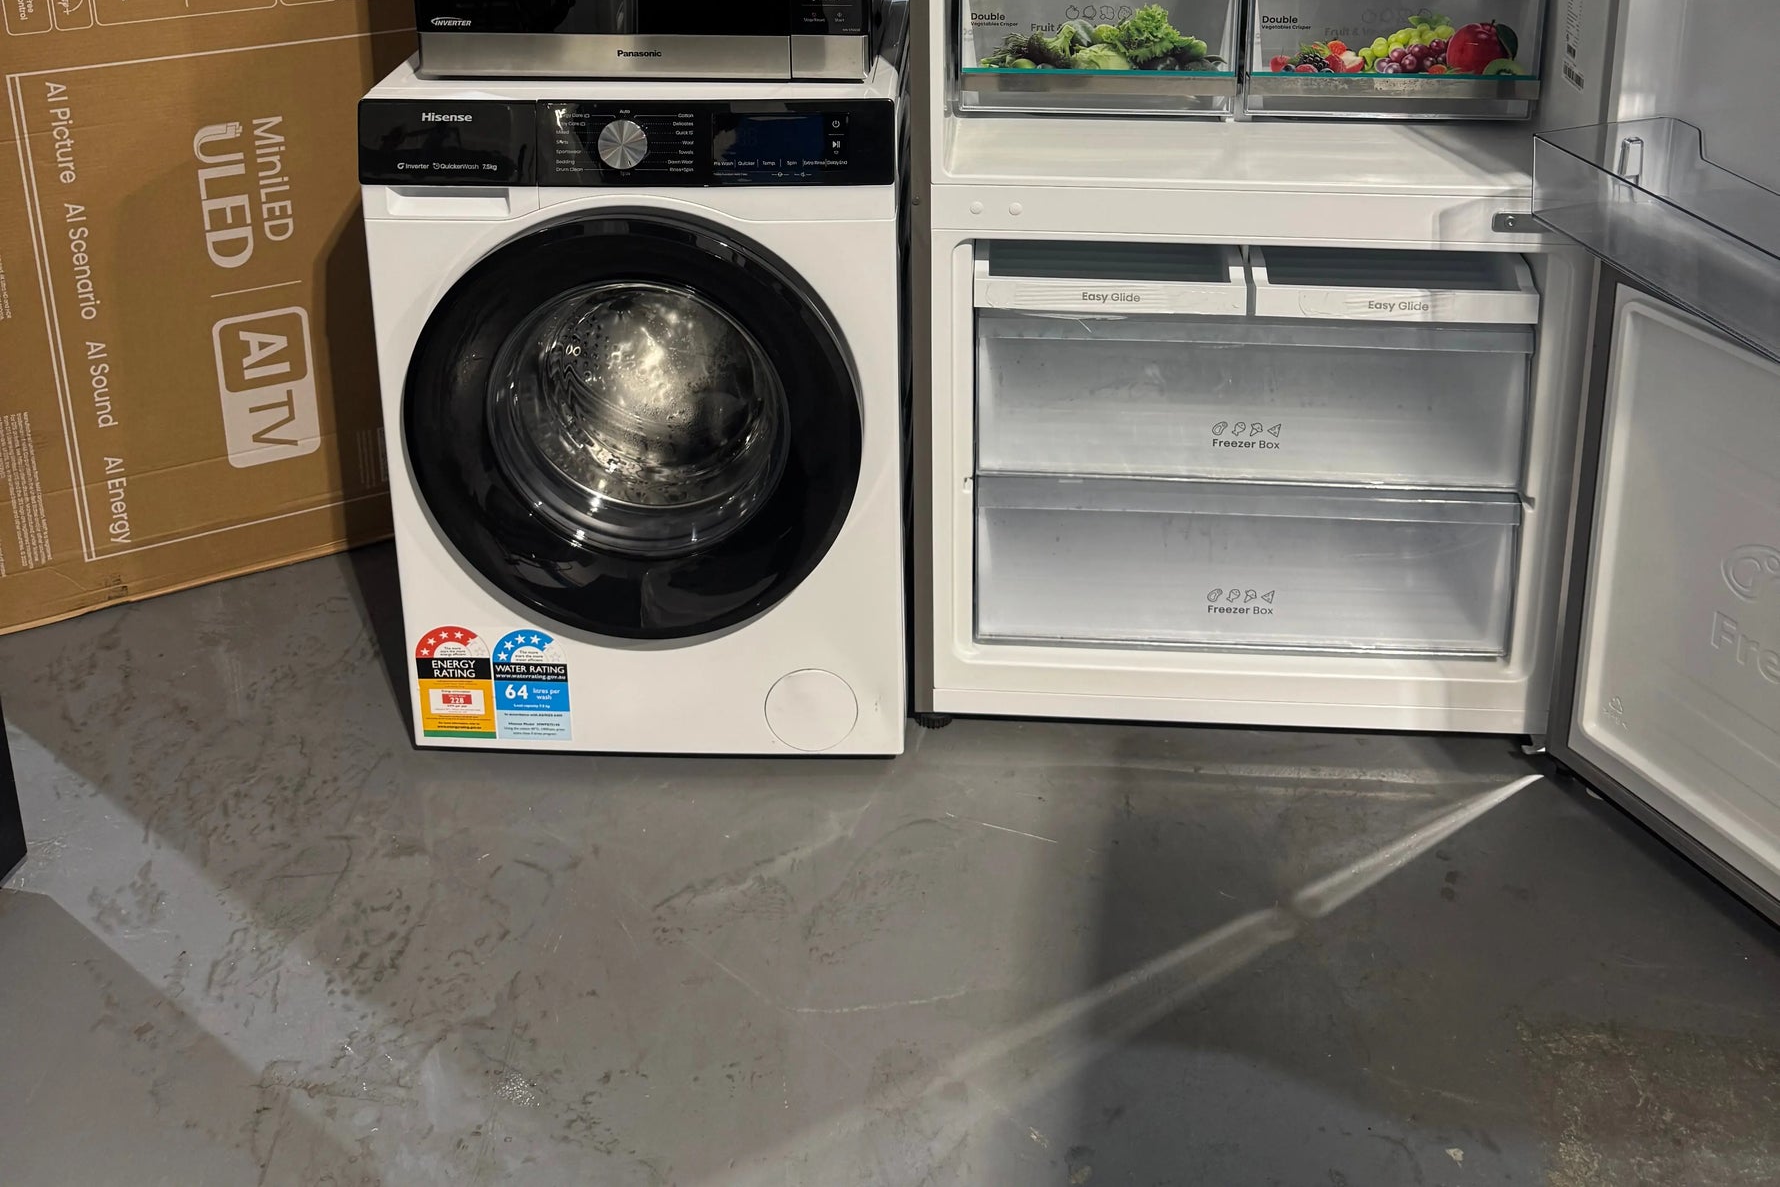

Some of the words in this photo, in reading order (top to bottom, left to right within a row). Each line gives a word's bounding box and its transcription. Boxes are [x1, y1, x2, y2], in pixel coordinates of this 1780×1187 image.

[435, 18, 472, 27] INVERTER
[1031, 23, 1054, 31] Fruit
[617, 50, 662, 58] Panasonic
[45, 81, 68, 102] AI
[421, 112, 473, 122] Hisense
[49, 107, 76, 184] Picture
[405, 162, 429, 170] Inverter
[440, 162, 479, 170] QuickerWash
[482, 163, 498, 171] 7.5kg
[252, 116, 294, 242] MiniLED
[193, 122, 254, 268] ULED
[63, 202, 86, 222] AI
[68, 227, 101, 320] Scenario
[1082, 291, 1109, 305] Easy
[1111, 291, 1141, 303] Glide
[1368, 300, 1395, 313] Easy
[1398, 301, 1429, 312] Glide
[85, 341, 108, 360] AI
[238, 330, 291, 381] AI
[89, 362, 119, 429] Sound
[249, 388, 298, 447] TV
[1212, 439, 1256, 449] Freezer
[1259, 440, 1280, 449] Box
[104, 456, 125, 475] AI
[107, 477, 131, 544] Energy
[1207, 605, 1250, 615] Freezer
[1253, 606, 1273, 615] Box
[432, 660, 475, 669] ENERGY
[495, 665, 527, 673] WATER
[530, 666, 565, 674] RATING
[434, 669, 475, 678] RATING
[505, 684, 529, 699] 64
